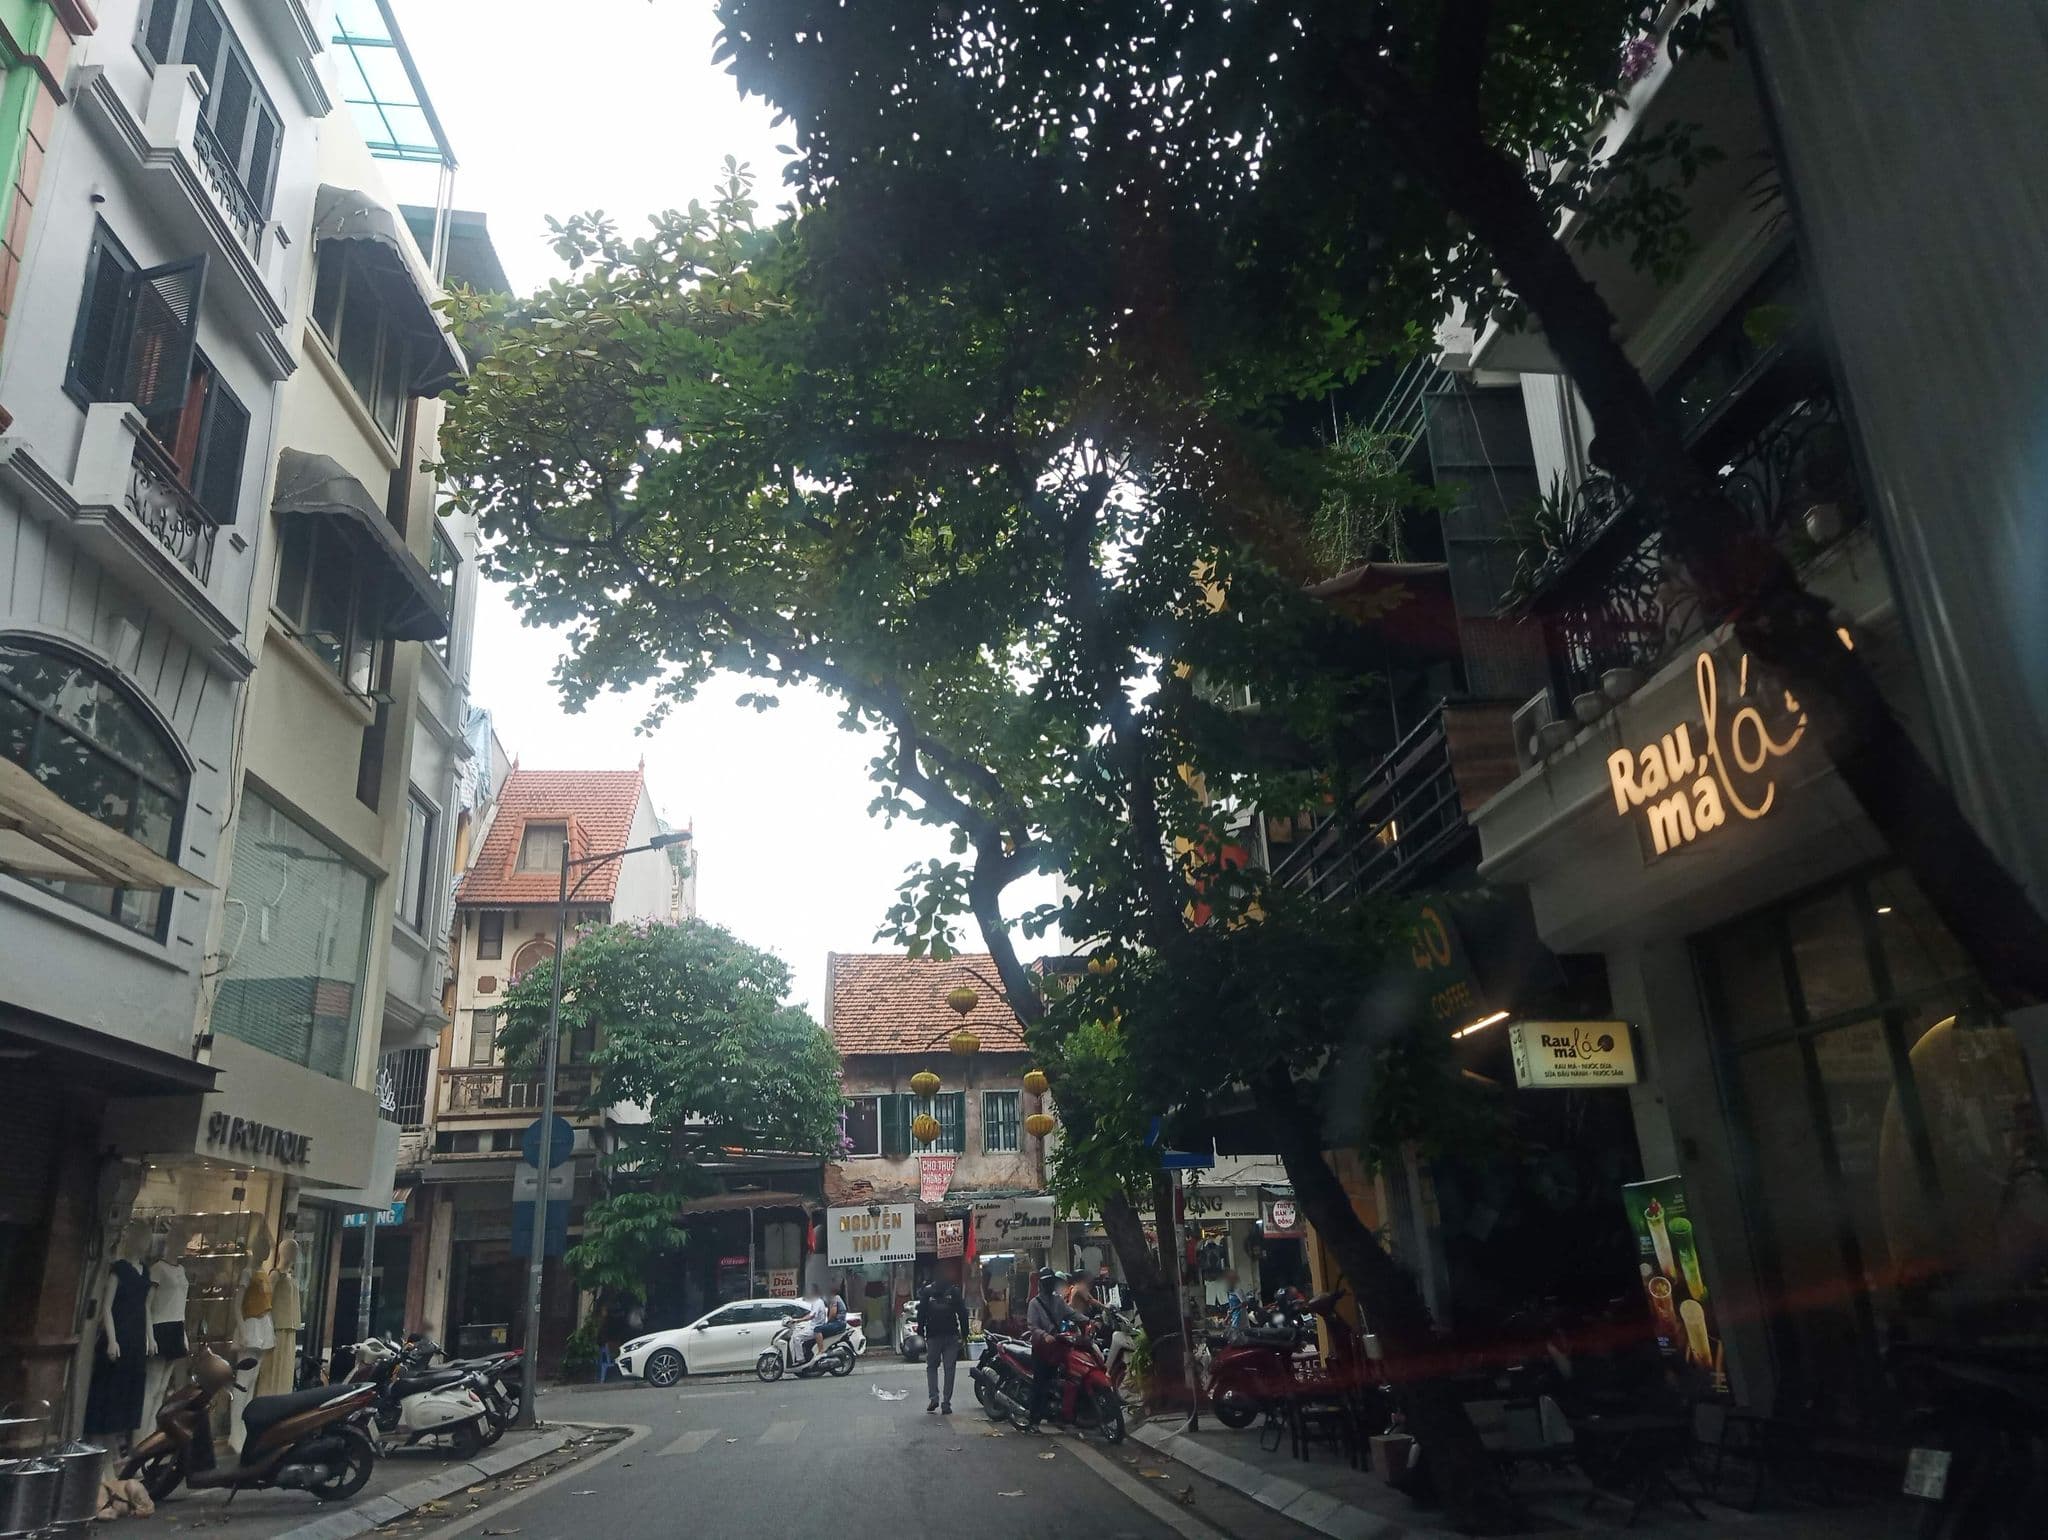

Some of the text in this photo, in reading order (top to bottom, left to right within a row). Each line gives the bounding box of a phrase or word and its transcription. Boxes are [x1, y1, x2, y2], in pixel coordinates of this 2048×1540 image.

[1607, 722, 1696, 816] Rau
[1646, 754, 1726, 855] má
[1541, 1034, 1571, 1047] Rau
[1554, 1045, 1577, 1058] má
[229, 1116, 313, 1166] BOUTIQUE
[359, 1210, 396, 1225] LNG
[839, 1206, 902, 1232] NGUYỄN
[852, 1231, 891, 1252] THÚY
